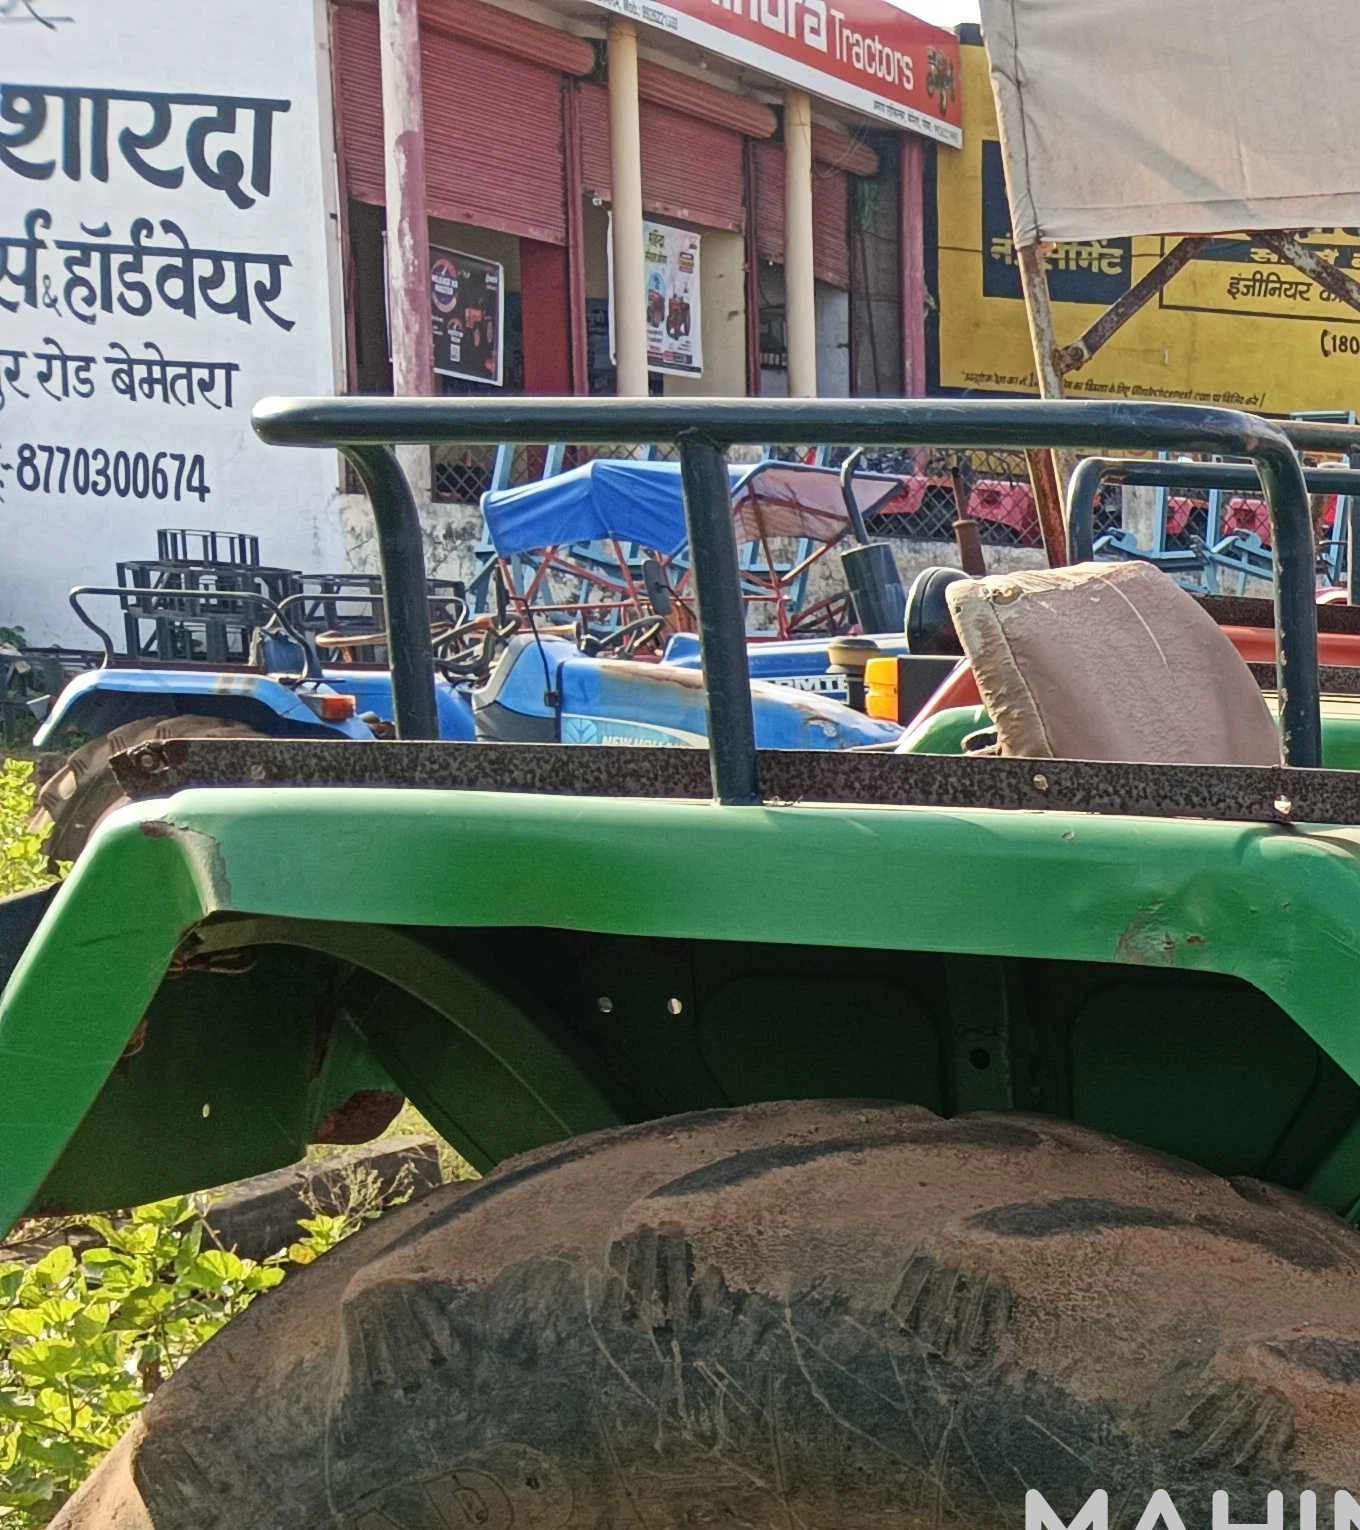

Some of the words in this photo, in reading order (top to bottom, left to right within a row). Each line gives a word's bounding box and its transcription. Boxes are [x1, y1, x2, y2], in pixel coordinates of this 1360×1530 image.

[829, 9, 915, 92] Tractors
[0, 82, 292, 210] शारदा
[1227, 270, 1313, 303] इंजीनियर
[34, 336, 98, 402] रोड
[104, 341, 241, 411] बेमेतरा
